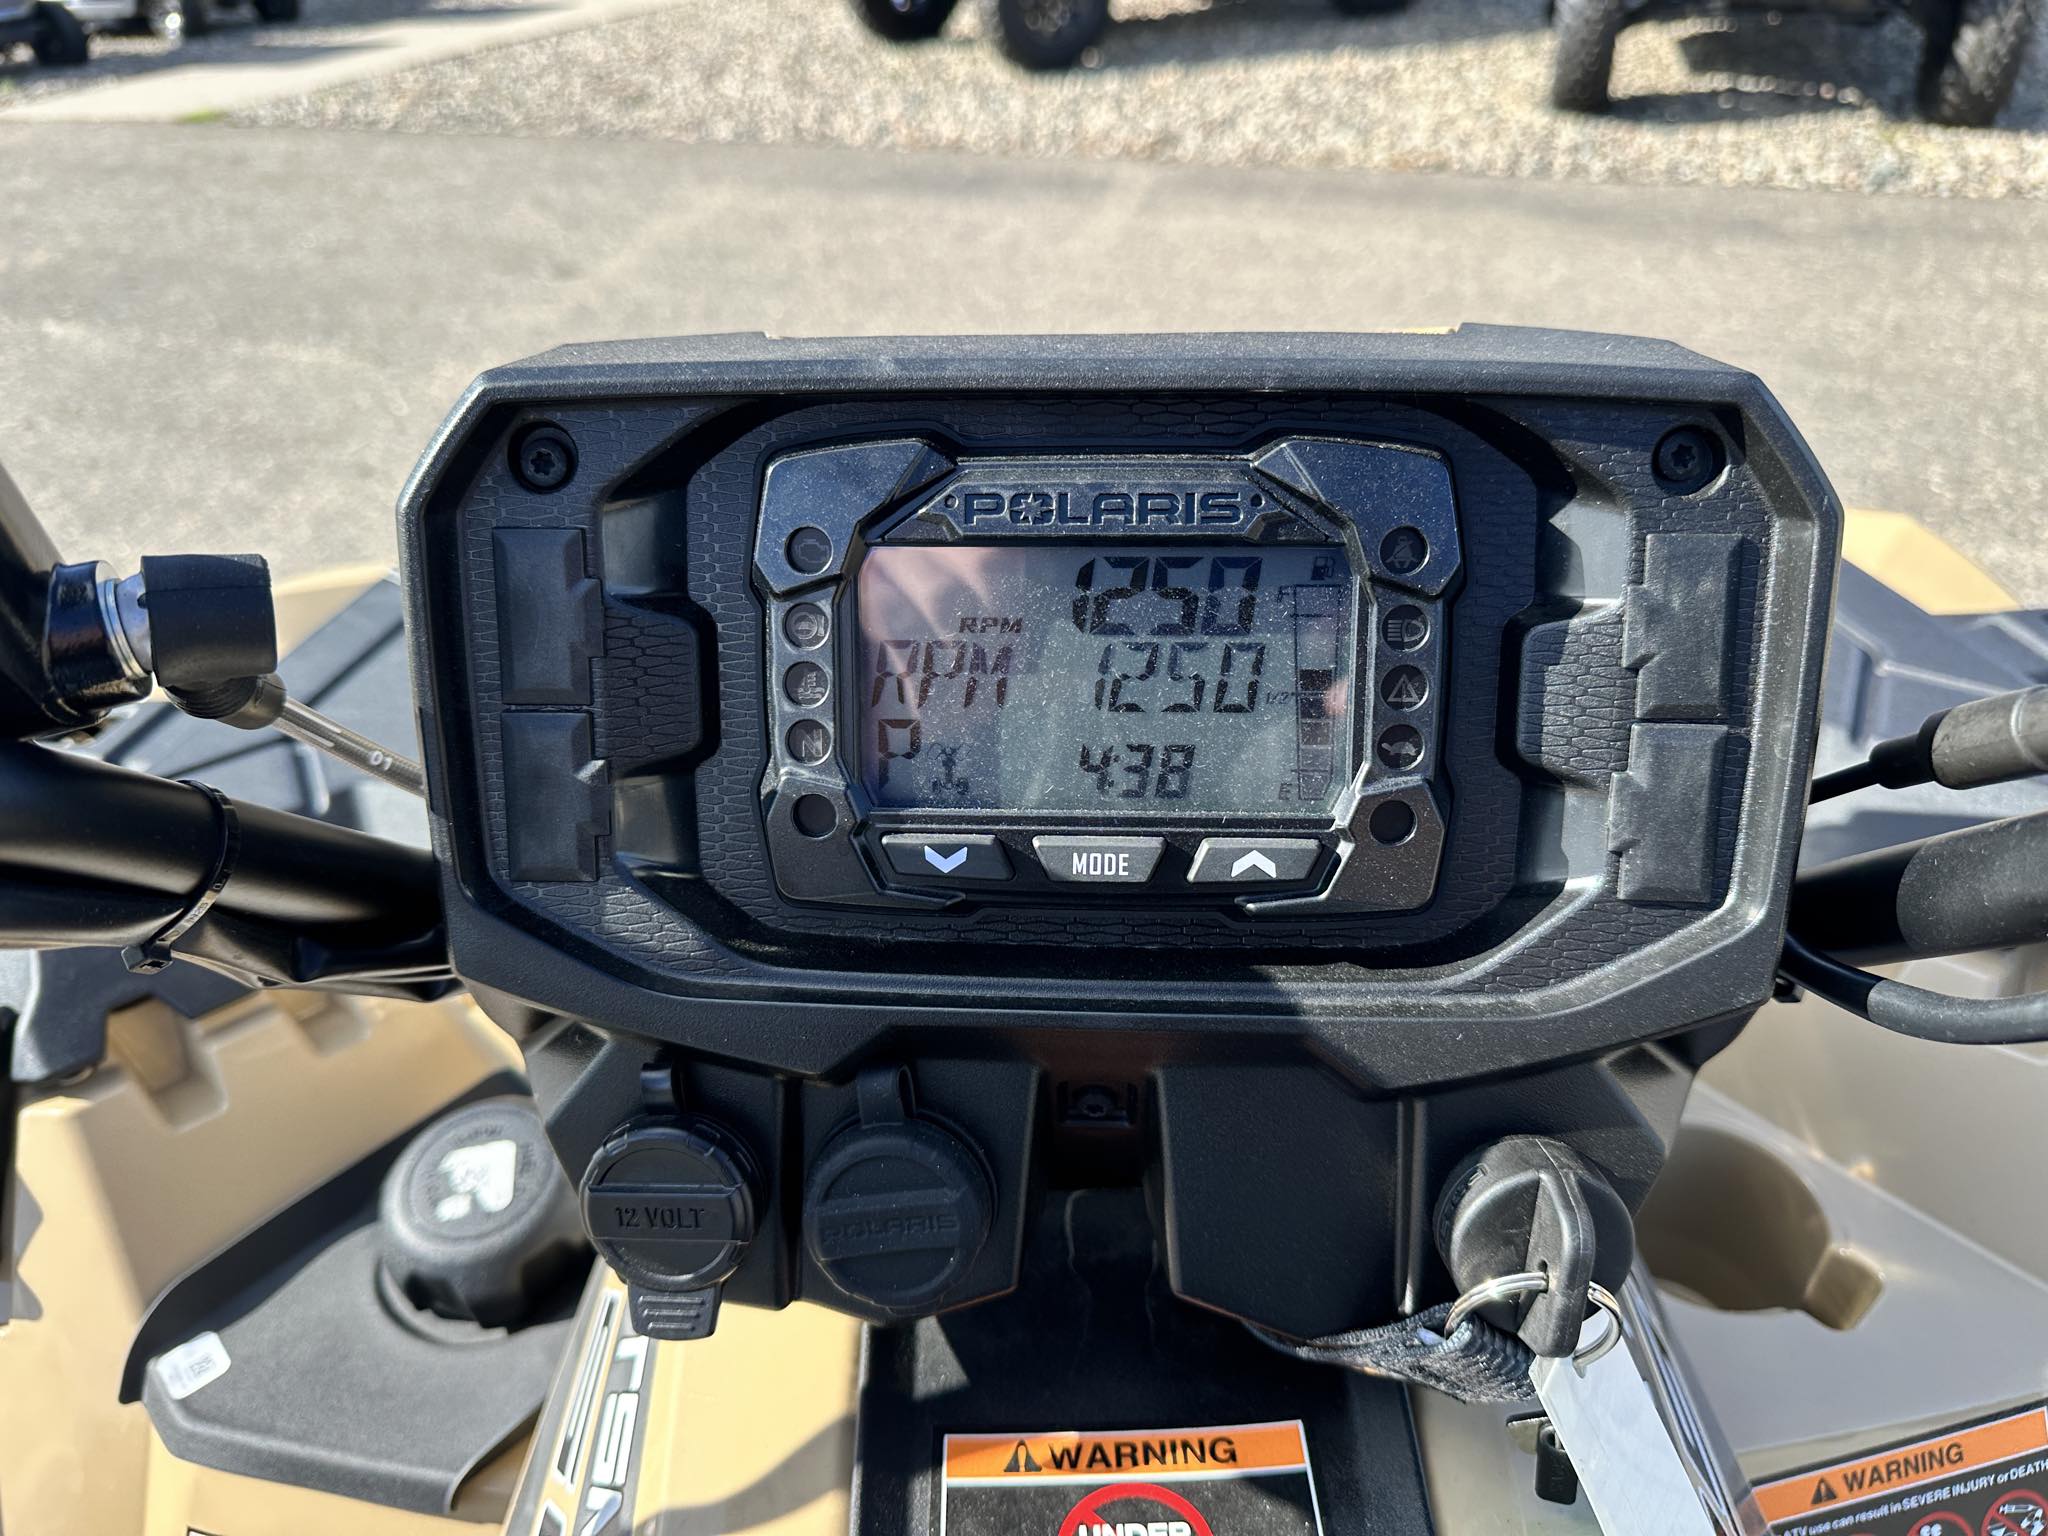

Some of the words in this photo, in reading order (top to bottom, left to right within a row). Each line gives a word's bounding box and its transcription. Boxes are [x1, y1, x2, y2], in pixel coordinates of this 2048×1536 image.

[964, 492, 1244, 526] POLARIS
[1072, 556, 1263, 636] 1250
[958, 616, 1023, 634] RPM
[871, 639, 1014, 709] RPM
[1094, 642, 1266, 712] 1250
[878, 718, 921, 791] P
[1079, 743, 1196, 799] 4:38
[1072, 852, 1130, 876] MODE
[614, 1206, 641, 1230] 12
[644, 1206, 706, 1231] VOLT
[1048, 1437, 1238, 1471] WARNING
[1842, 1442, 1965, 1494] WARNING
[1831, 1515, 1855, 1530] can
[1855, 1504, 1889, 1523] result
[1901, 1486, 1952, 1511] SEVERE
[1951, 1474, 1995, 1497] INJURY
[1996, 1472, 2009, 1485] or
[2009, 1458, 2048, 1480] DEATH
